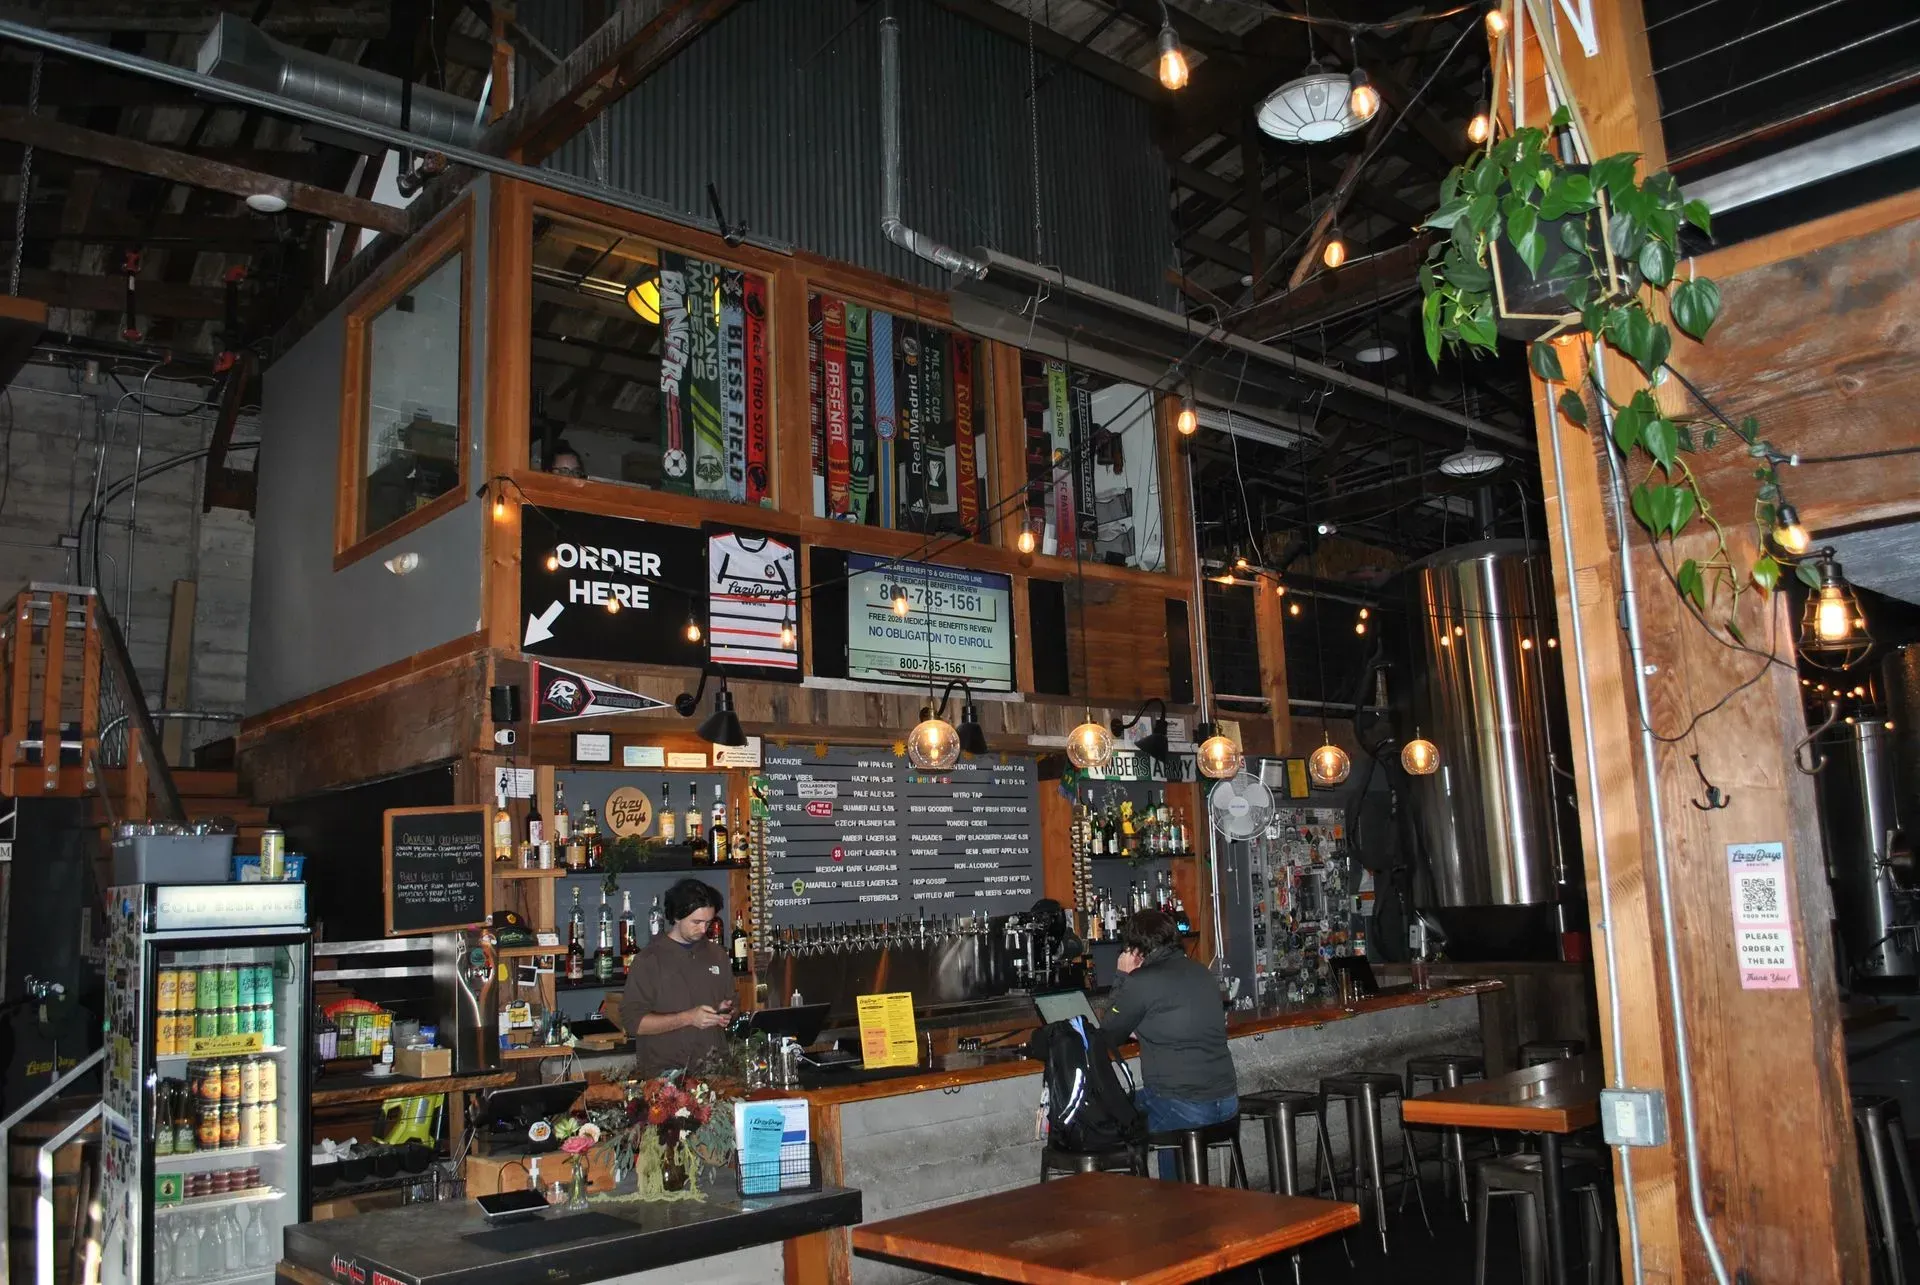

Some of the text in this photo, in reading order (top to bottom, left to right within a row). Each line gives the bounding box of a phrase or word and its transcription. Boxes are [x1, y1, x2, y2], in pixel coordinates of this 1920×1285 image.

[684, 258, 705, 380] IMBERS
[702, 261, 719, 381] ORTLAND
[660, 270, 691, 397] BANGERS
[728, 323, 743, 483] BLESS FIELD
[827, 360, 843, 444] ARSENAL
[851, 360, 865, 473] PICKLES
[556, 543, 661, 577] ORDER
[930, 580, 956, 590] BENEFITS
[957, 584, 978, 594] REVIEW
[569, 579, 650, 609] HERE
[868, 612, 886, 622] FREE
[904, 616, 937, 628] MEDICARE
[939, 621, 968, 631] BENEFITS
[969, 624, 993, 634] REVIEW
[868, 625, 993, 649] NO OBLIGATION TO ENROLL
[900, 657, 967, 675] 800-785-1561
[1153, 759, 1193, 779] ARMY
[766, 773, 793, 781] TURDAY
[851, 775, 869, 783] HAZY
[853, 790, 868, 798] PALE
[869, 790, 881, 798] ALE
[611, 795, 643, 815] Lazy
[785, 804, 802, 812] SALE
[842, 804, 881, 812] SUMMER ALE
[927, 805, 954, 813] GOODBYE
[616, 810, 646, 828] Days
[834, 819, 857, 827] CZECH
[858, 820, 883, 828] PILSNER
[865, 834, 885, 842] LAGER
[911, 834, 943, 842] PALISADES
[844, 849, 863, 857] LIGHT
[865, 849, 885, 857] LAGER
[911, 848, 939, 856] VANTAGE
[846, 865, 863, 873] DARK
[805, 881, 837, 889] AMARILLO
[866, 879, 886, 888] LAGER
[926, 877, 947, 885] GOSSIP
[913, 891, 955, 900] UNTITLED ART
[1017, 888, 1032, 896] POUR
[1742, 945, 1771, 953] ORDER
[1746, 973, 1768, 982] Thank
